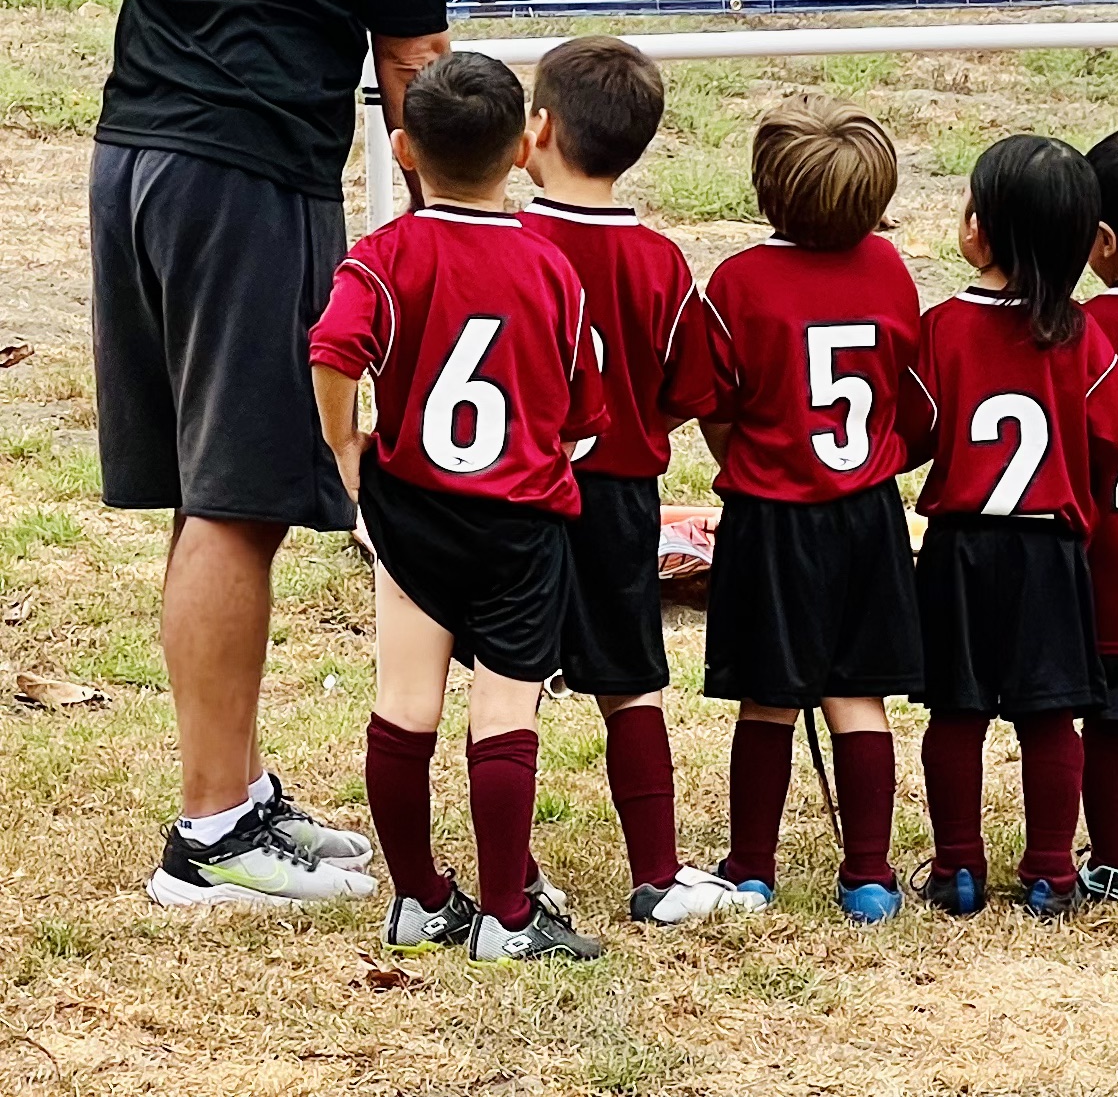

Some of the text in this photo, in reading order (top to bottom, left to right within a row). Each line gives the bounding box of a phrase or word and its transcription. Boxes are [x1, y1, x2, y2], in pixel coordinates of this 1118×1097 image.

[421, 317, 508, 473] 6
[807, 323, 878, 471] 5
[970, 393, 1054, 519] 2
